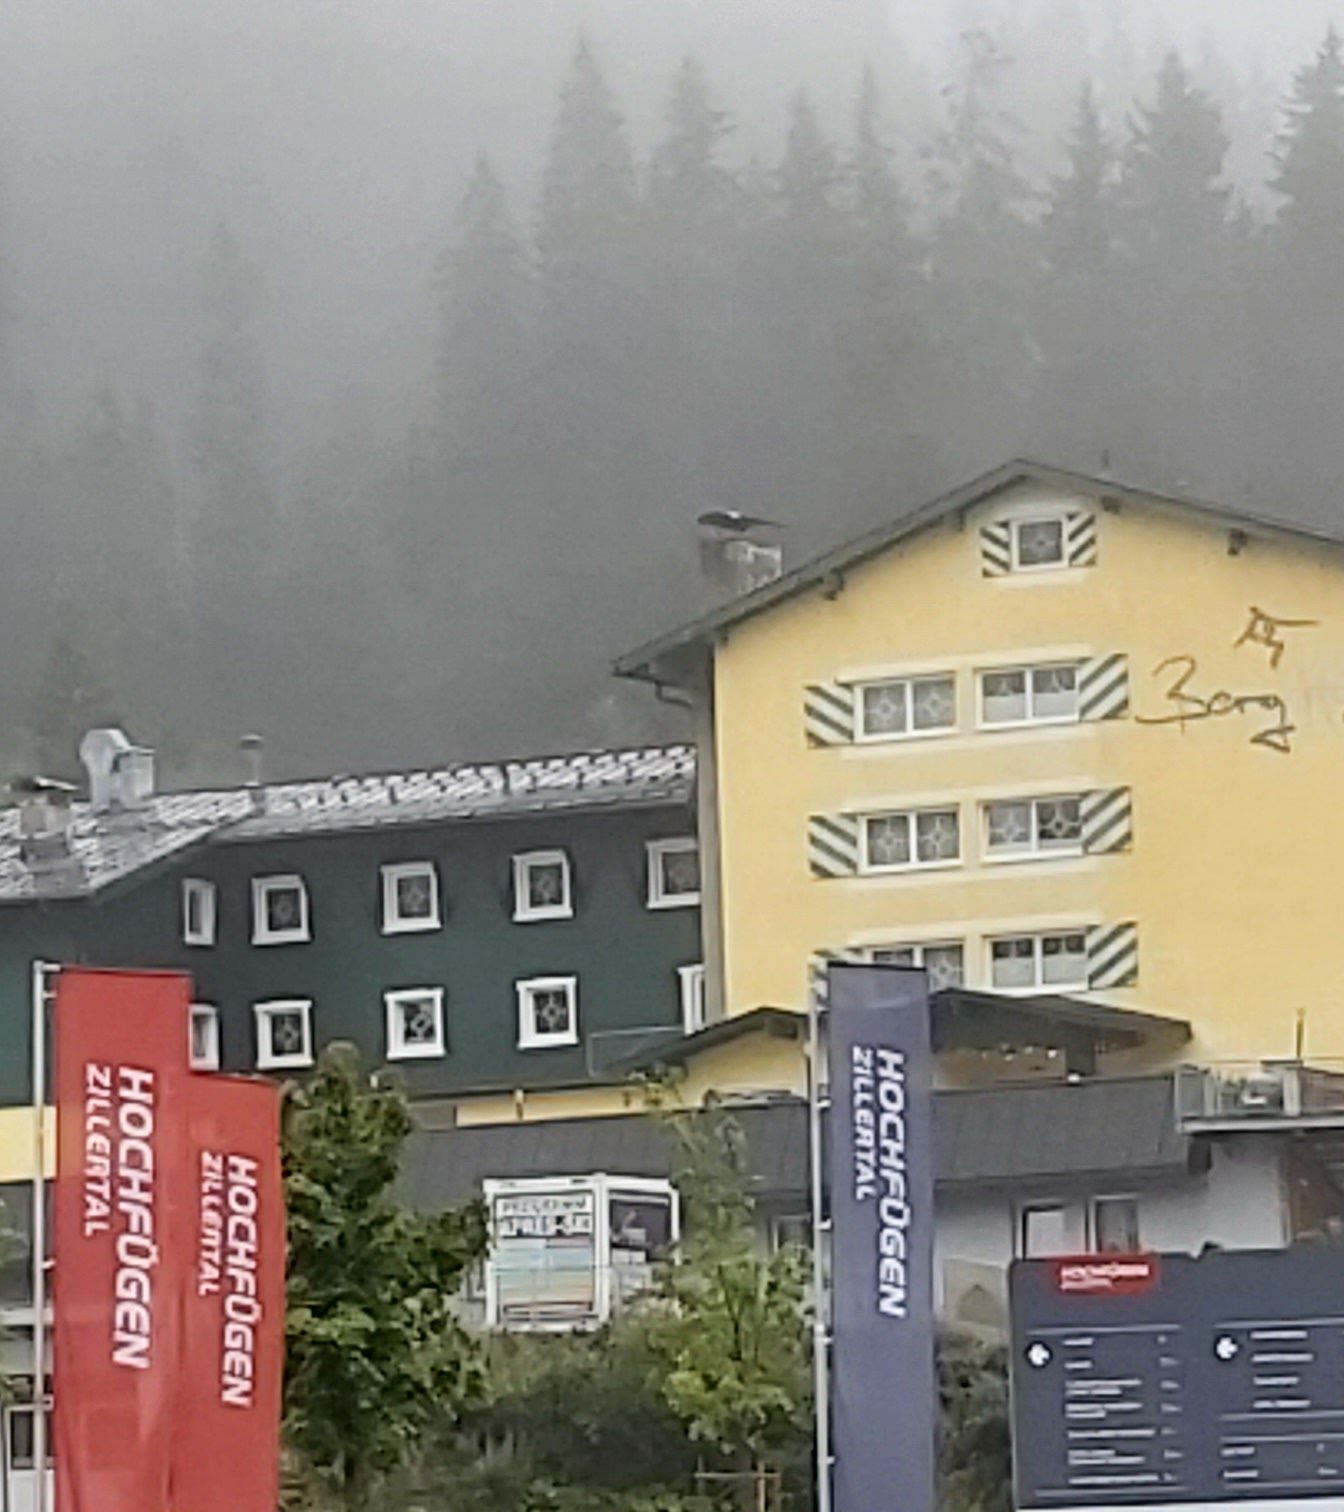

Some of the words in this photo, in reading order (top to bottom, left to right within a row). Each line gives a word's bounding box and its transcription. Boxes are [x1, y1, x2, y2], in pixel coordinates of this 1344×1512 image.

[84, 1062, 111, 1237] ZILLERTAL
[112, 1065, 159, 1370] HOCHFÜGEN
[198, 1150, 223, 1296] ZILLERTAL
[853, 1045, 876, 1201] ZILLERTAL
[877, 1048, 911, 1319] HOCHFÜGEN
[221, 1154, 263, 1407] HOCHFÜGEN
